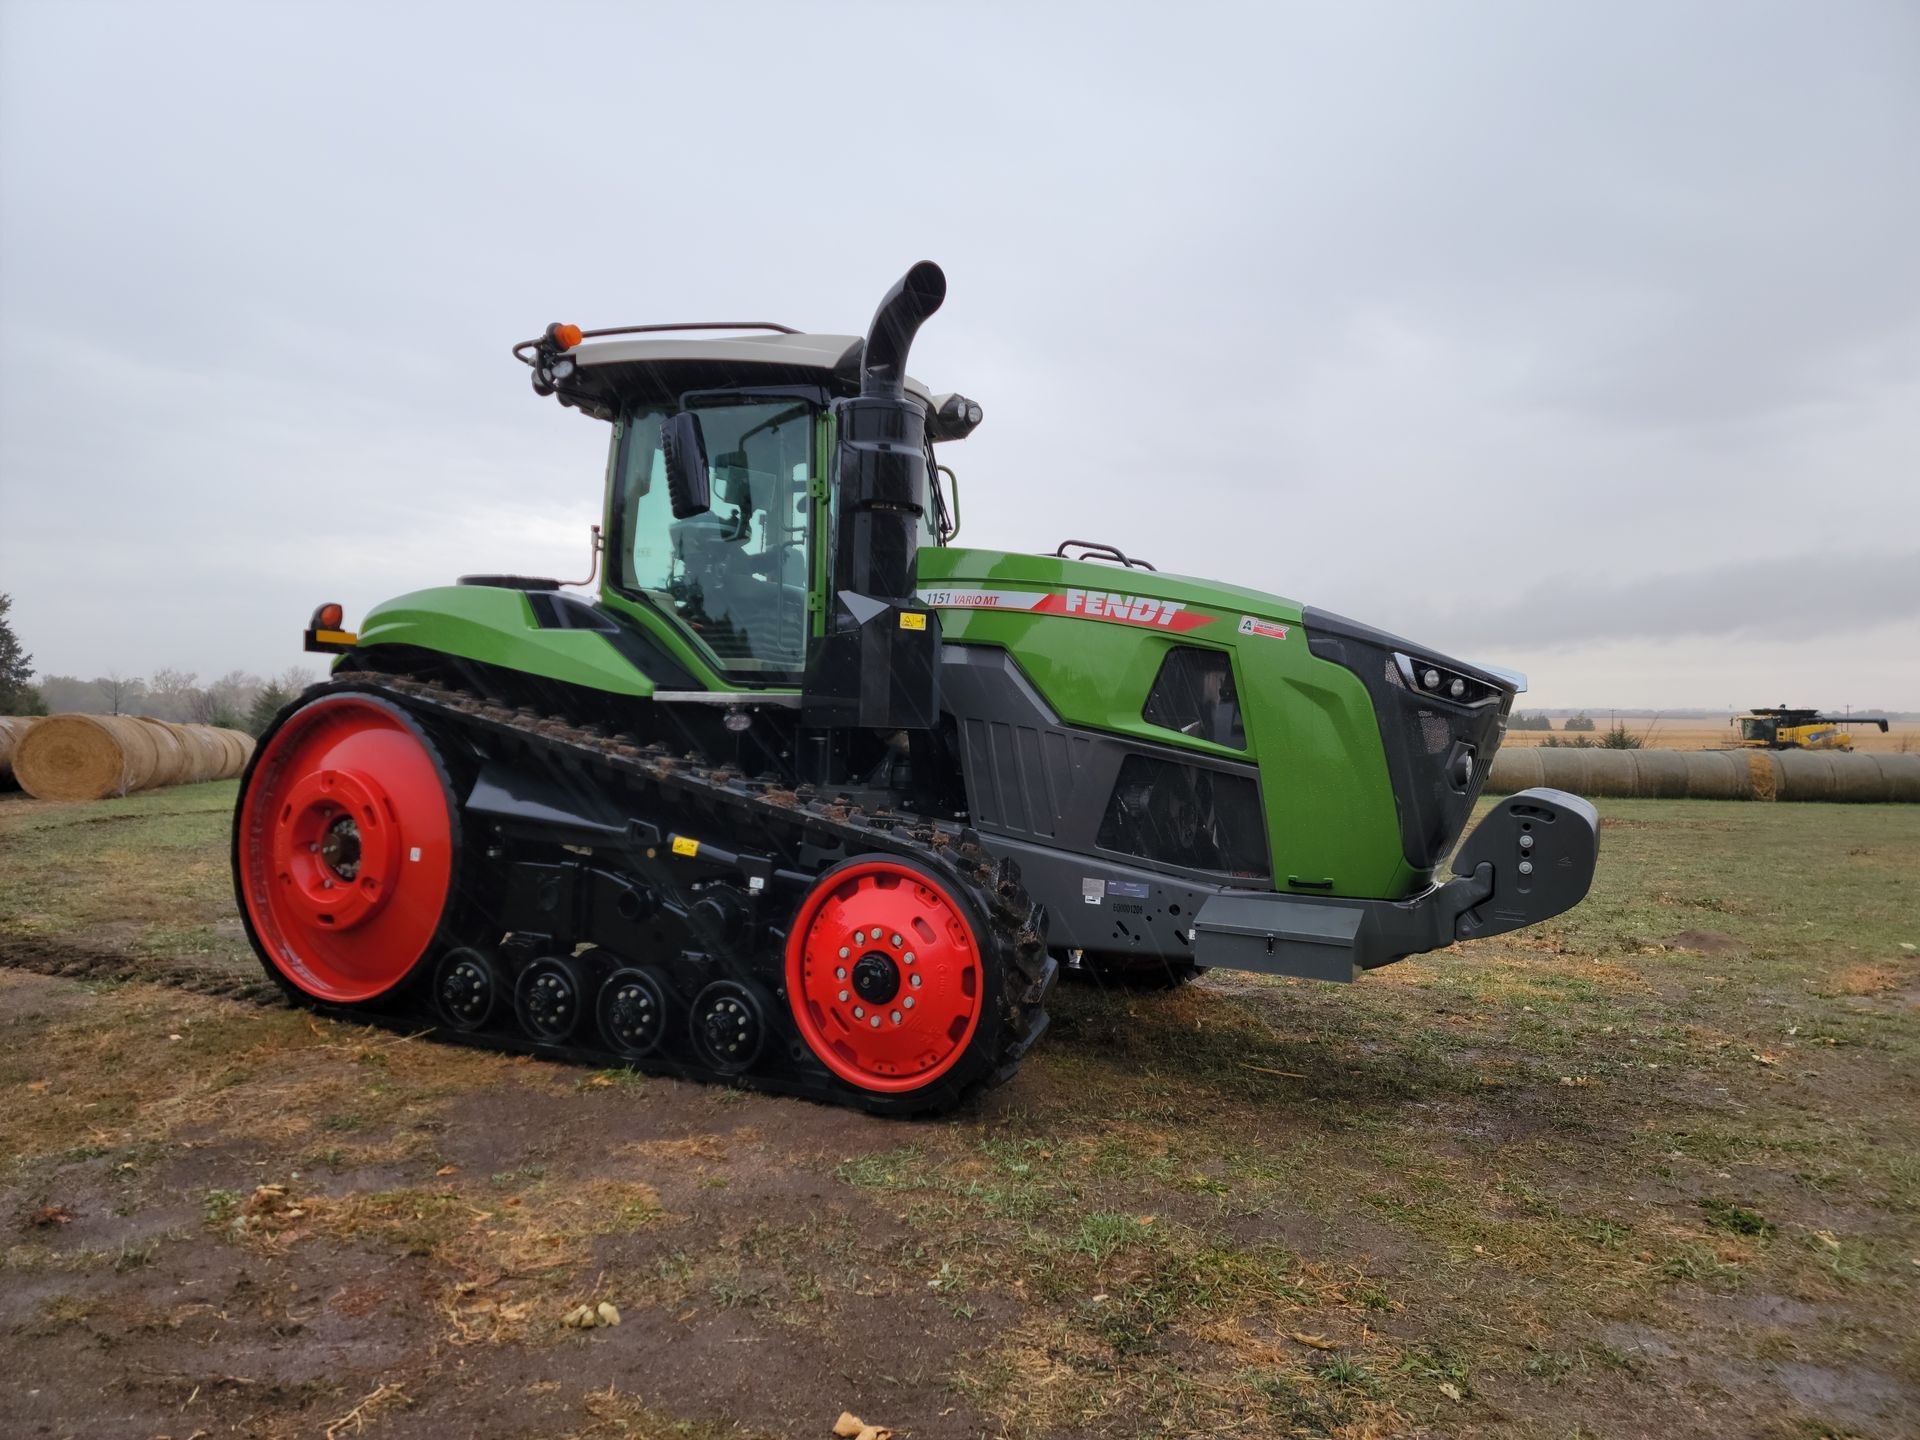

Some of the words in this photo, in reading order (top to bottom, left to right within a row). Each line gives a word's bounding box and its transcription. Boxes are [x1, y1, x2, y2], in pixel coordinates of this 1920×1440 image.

[927, 592, 951, 605] 1151
[954, 594, 982, 605] VARIO
[983, 595, 1000, 606] MT
[1066, 588, 1187, 625] FENDT
